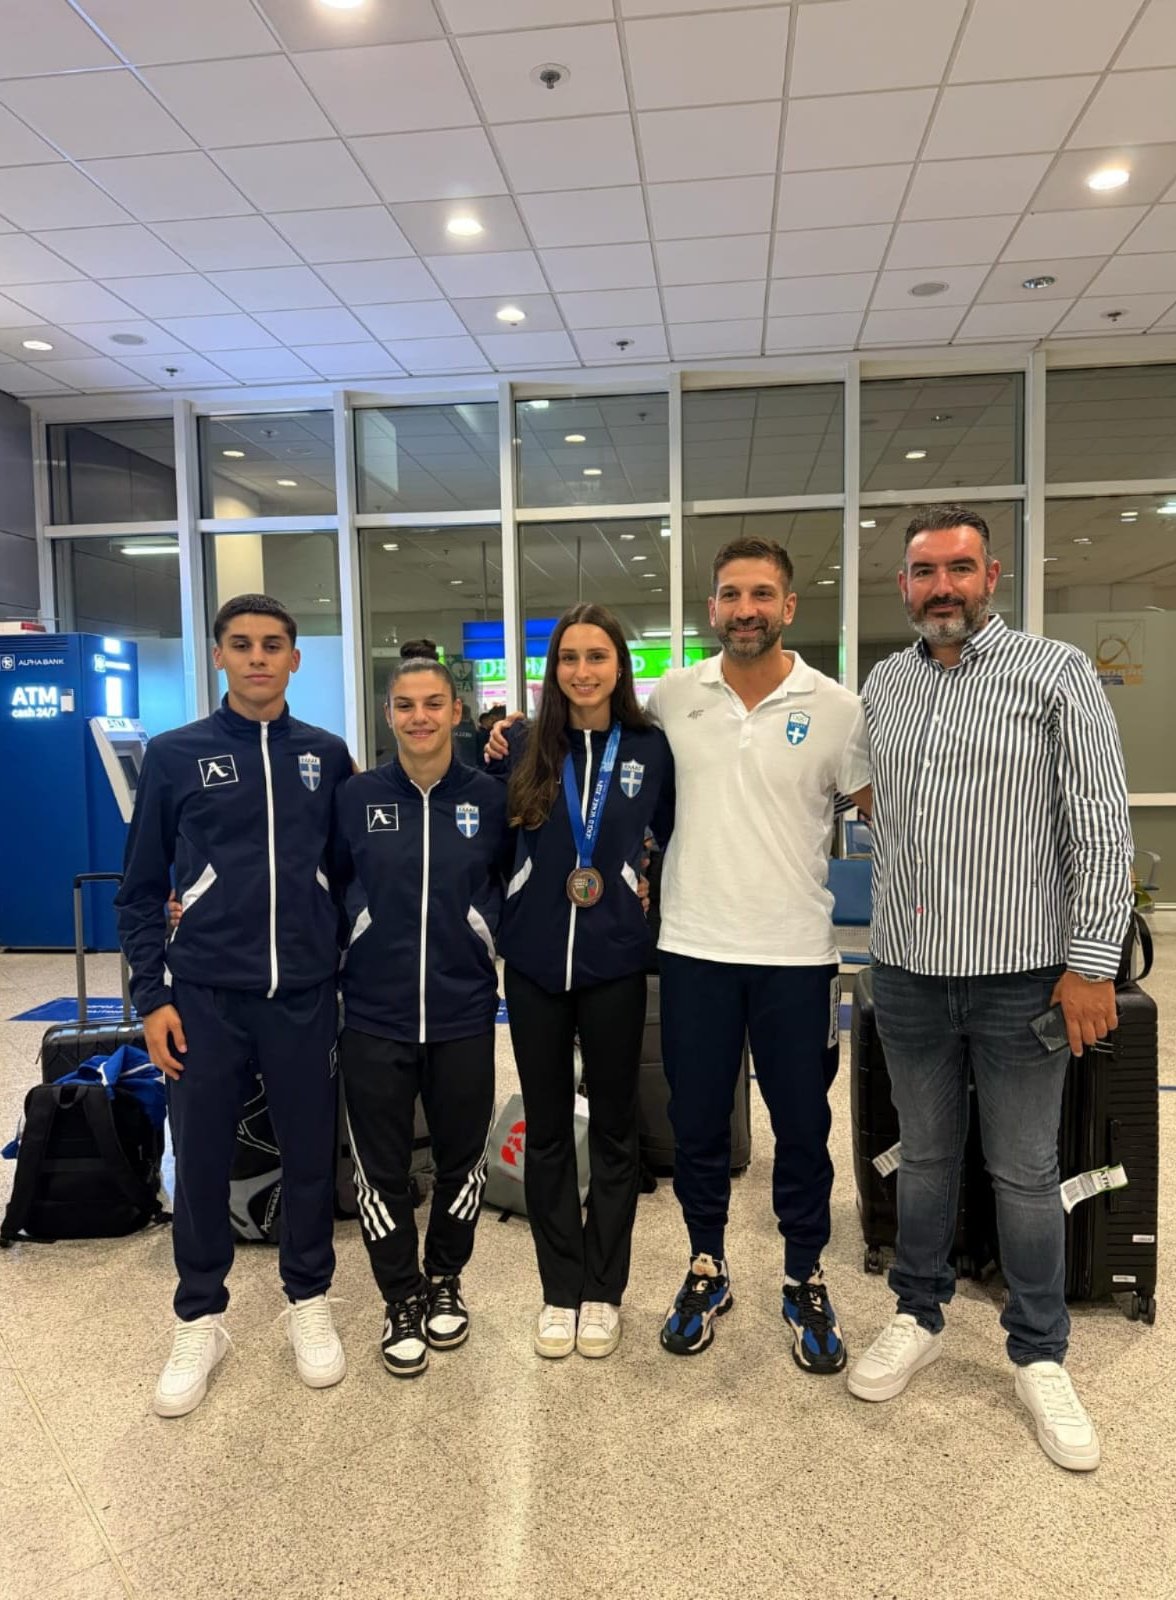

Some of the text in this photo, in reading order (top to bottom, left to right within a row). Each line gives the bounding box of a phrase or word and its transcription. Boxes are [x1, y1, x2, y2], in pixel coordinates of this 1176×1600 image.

[11, 686, 57, 705] ATM
[11, 706, 58, 718] cash 24/7
